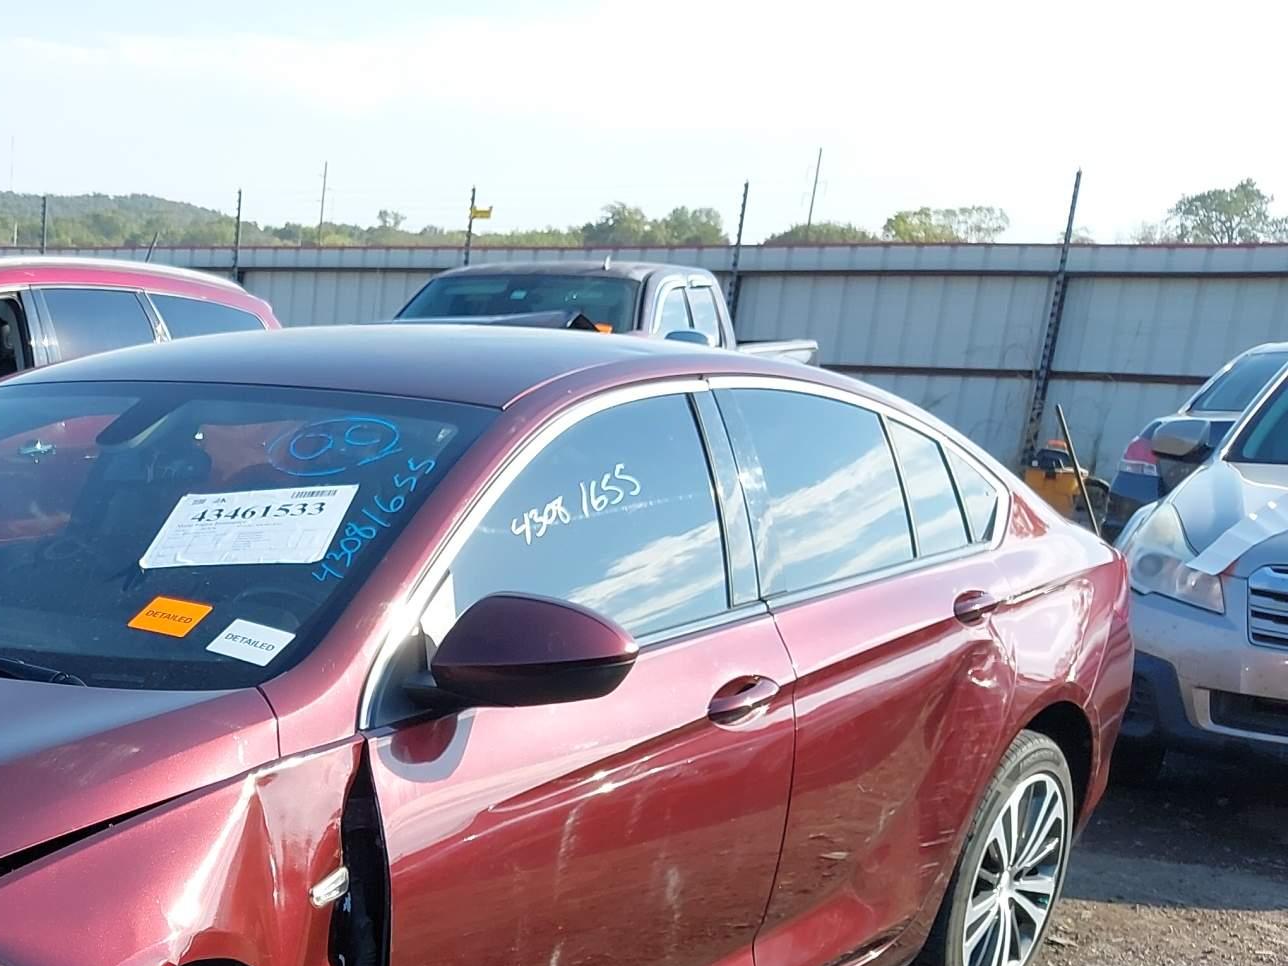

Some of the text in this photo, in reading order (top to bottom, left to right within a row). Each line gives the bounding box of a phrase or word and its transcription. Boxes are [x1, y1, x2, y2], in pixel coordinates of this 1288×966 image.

[191, 501, 327, 522] 43461533
[145, 609, 193, 624] DETAILED
[224, 632, 275, 652] DETAILED
